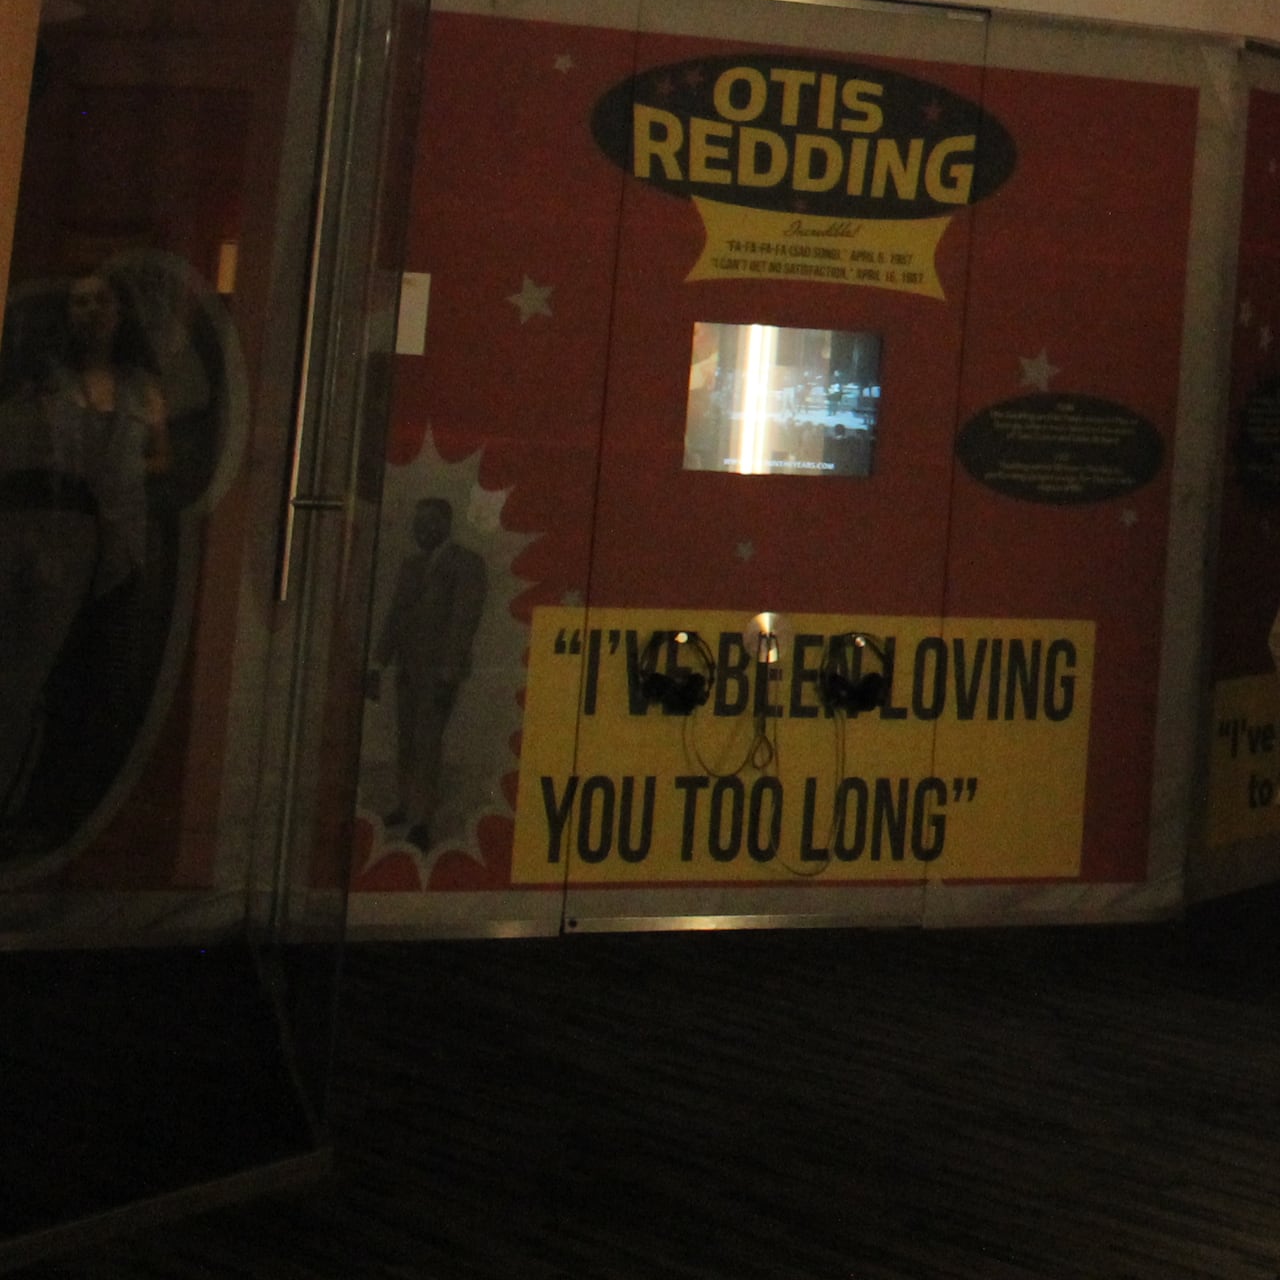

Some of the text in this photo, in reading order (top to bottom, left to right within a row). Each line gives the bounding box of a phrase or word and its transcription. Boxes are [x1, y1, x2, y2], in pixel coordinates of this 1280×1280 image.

[713, 66, 884, 134] OTIS
[633, 103, 977, 205] REDDING
[879, 637, 1077, 722] LOVING
[540, 775, 978, 864] YOU TOO LONG"
